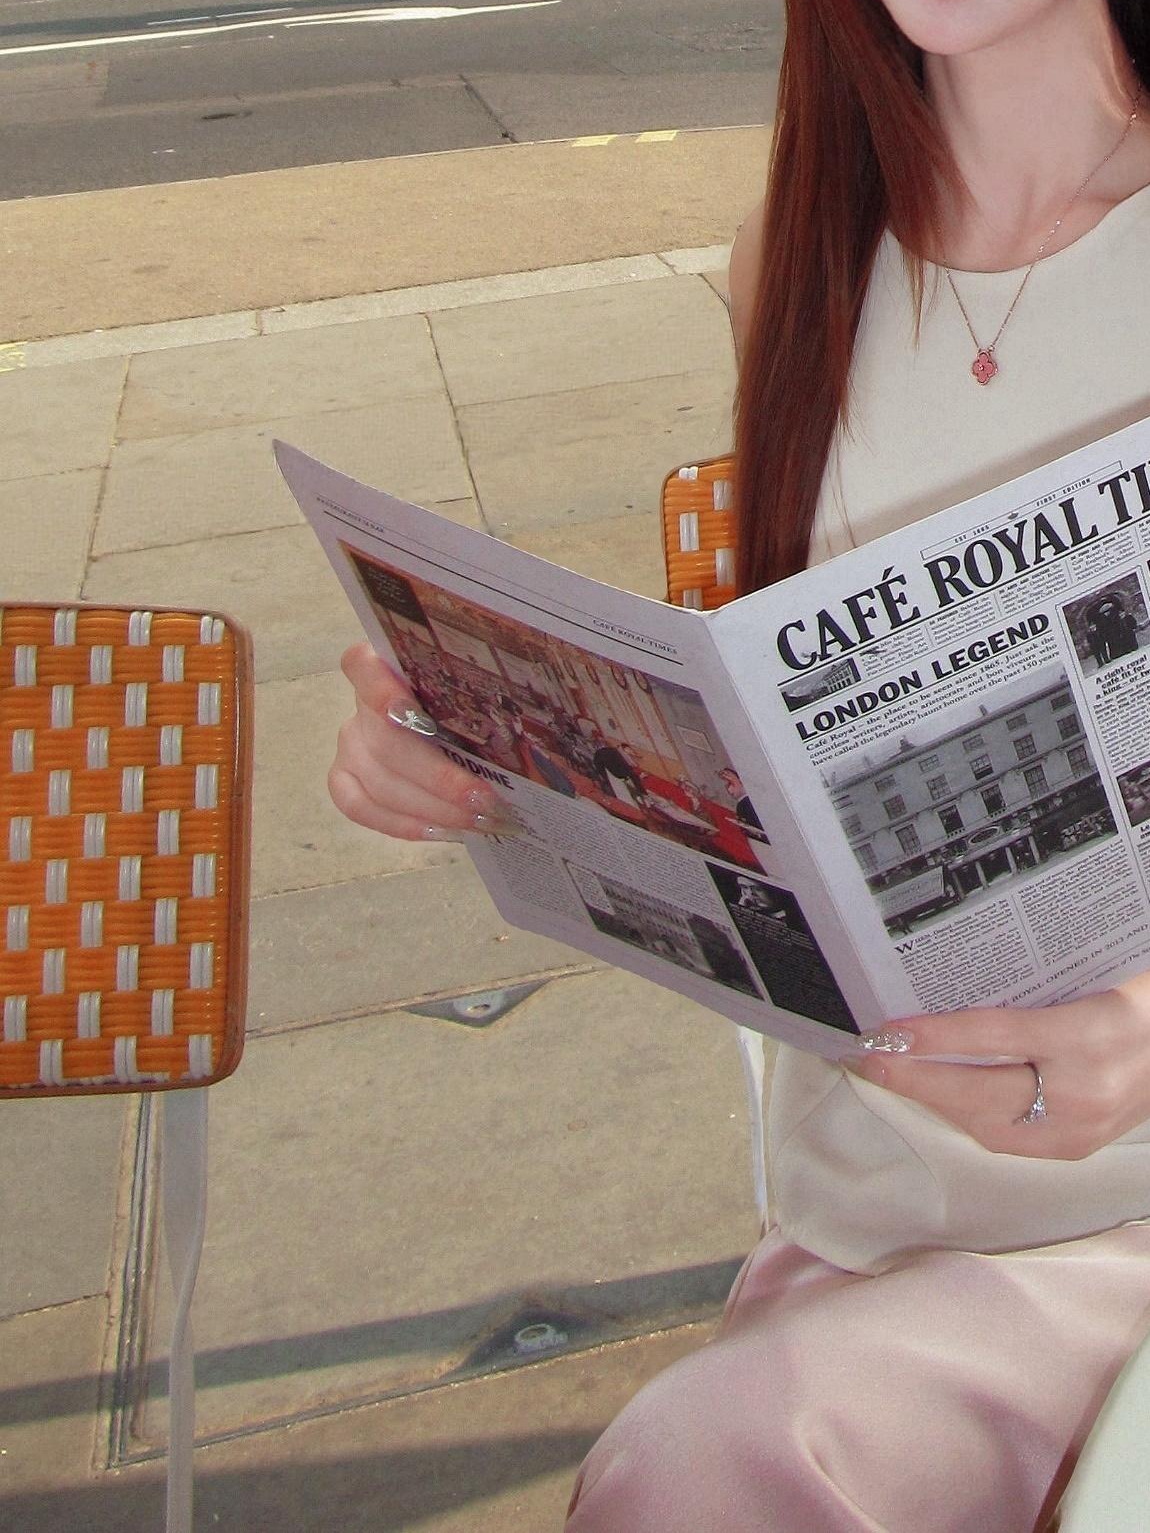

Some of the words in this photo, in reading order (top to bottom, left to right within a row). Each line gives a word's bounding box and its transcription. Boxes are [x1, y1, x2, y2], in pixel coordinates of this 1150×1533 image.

[776, 566, 921, 671] CAFÉ
[924, 497, 1099, 608] ROYAL
[796, 670, 923, 741] LONDON
[931, 614, 1049, 680] LEGEND
[805, 737, 827, 752] Café
[829, 724, 857, 742] Royal
[866, 714, 879, 725] the
[882, 702, 907, 719] place
[908, 697, 918, 706] to
[919, 690, 931, 700] be
[932, 682, 953, 694] seen
[954, 670, 977, 685] since
[1005, 650, 1022, 663] Just
[1023, 641, 1039, 653] ask
[1040, 634, 1055, 645] the
[808, 736, 850, 759] countless
[887, 706, 918, 724] artists,
[919, 684, 965, 710] aristocrats
[966, 675, 984, 688] and
[985, 666, 1003, 679] bon
[1038, 642, 1057, 654] who
[811, 752, 833, 766] have
[832, 740, 859, 757] called
[859, 734, 874, 745] the
[874, 714, 918, 739] legendary
[917, 702, 942, 719] haunt
[942, 691, 968, 707] home
[967, 682, 987, 696] over
[987, 674, 1003, 686] the
[1002, 667, 1021, 681] past
[1021, 659, 1038, 671] 150
[1037, 649, 1060, 664] years
[1094, 675, 1103, 684] A
[1103, 665, 1125, 680] right
[1125, 654, 1147, 669] royal
[1100, 675, 1120, 689] café
[1120, 669, 1131, 679] fit
[1132, 663, 1146, 674] for
[1102, 682, 1122, 696] king
[1128, 674, 1138, 683] or
[465, 757, 515, 790] DINE
[1010, 982, 1045, 1003] ROYAL
[1043, 955, 1090, 983] OPENED
[1089, 948, 1103, 958] IN
[1104, 936, 1125, 950] 2013
[1124, 923, 1149, 939] AND
